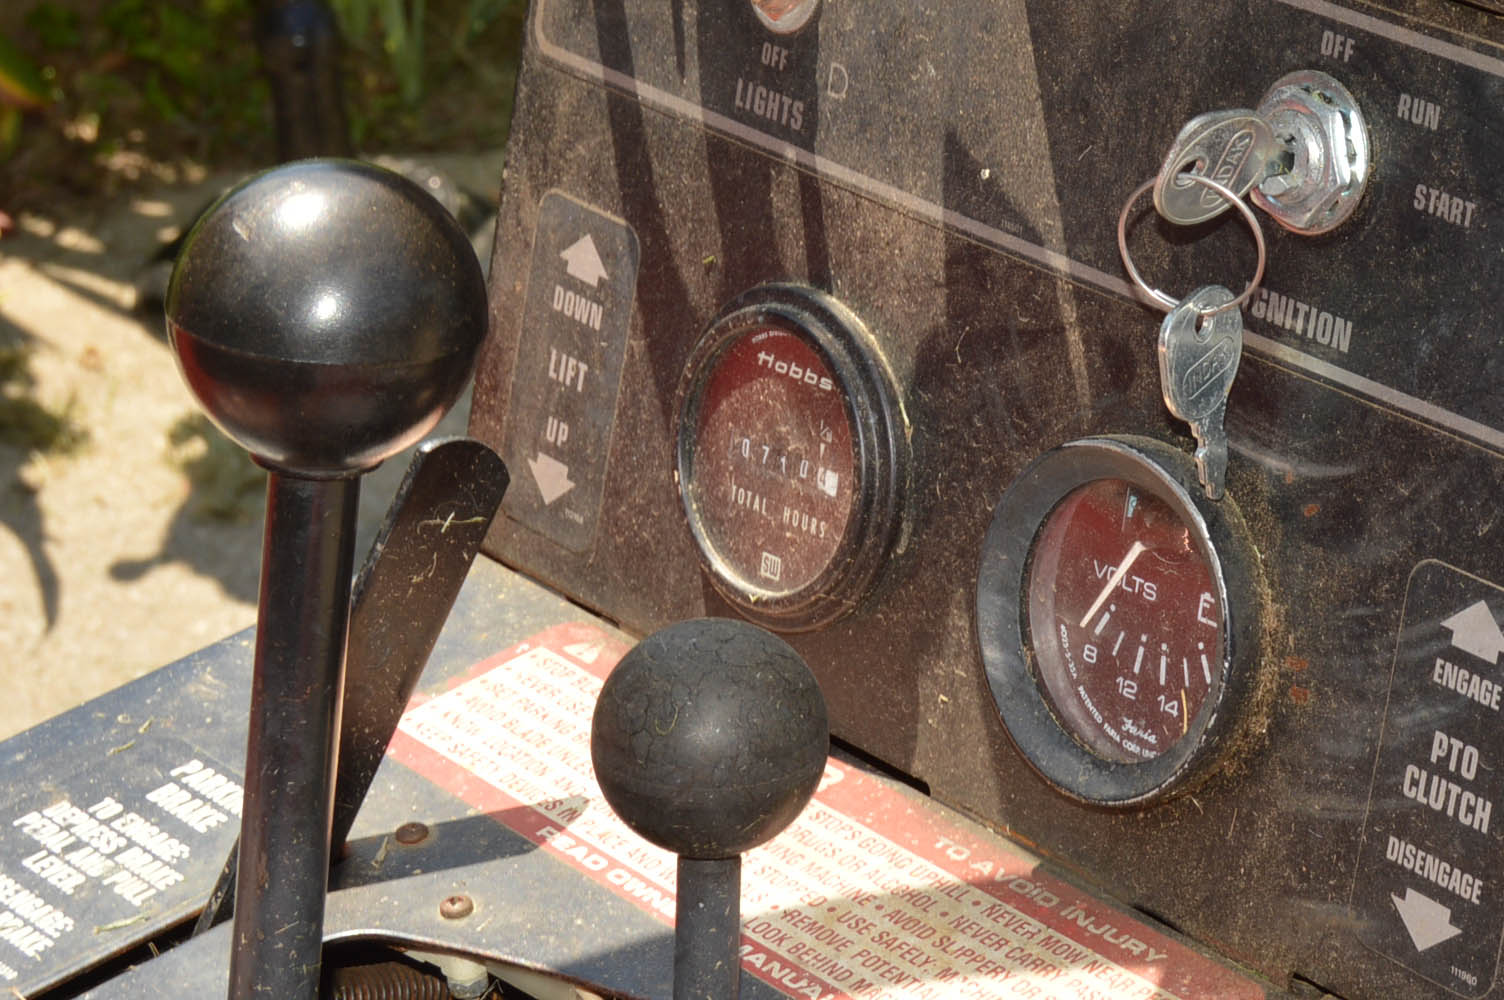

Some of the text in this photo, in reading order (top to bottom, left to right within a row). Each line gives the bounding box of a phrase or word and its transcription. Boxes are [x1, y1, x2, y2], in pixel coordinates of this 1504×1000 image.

[760, 41, 789, 73] OFF
[1320, 30, 1357, 63] OFF
[733, 77, 805, 131] LIGHTS
[1397, 92, 1442, 132] RUN
[1413, 182, 1478, 230] START
[552, 284, 604, 331] DOWN
[548, 349, 589, 393] LIFT
[757, 350, 833, 392] Hobbs
[546, 415, 570, 448] UP
[731, 483, 827, 539] TOTAL HOURS
[1083, 643, 1098, 664] 8
[1115, 676, 1138, 701] 12
[1157, 694, 1179, 719] 14
[1432, 657, 1503, 712] ENGAGE
[1430, 729, 1479, 781] PTO
[146, 782, 228, 834] BRAKE
[1402, 764, 1493, 835] CLUTCH
[535, 825, 609, 872] READ
[1386, 835, 1483, 905] DISENGAGE
[836, 910, 877, 935] USE
[934, 837, 1169, 962] TO AVOID INJURY
[744, 916, 854, 982] LOOK BEHIND
[781, 909, 856, 953] REMOVE
[881, 909, 937, 941] AVOID
[931, 935, 1016, 983] SLIPPERY
[908, 865, 971, 904] UPHILL
[979, 902, 1042, 941] NEVER
[1036, 934, 1089, 964] MOW
[1082, 961, 1129, 991] NEAR
[948, 914, 1010, 951] NEVER
[1004, 946, 1062, 979] CARRY
